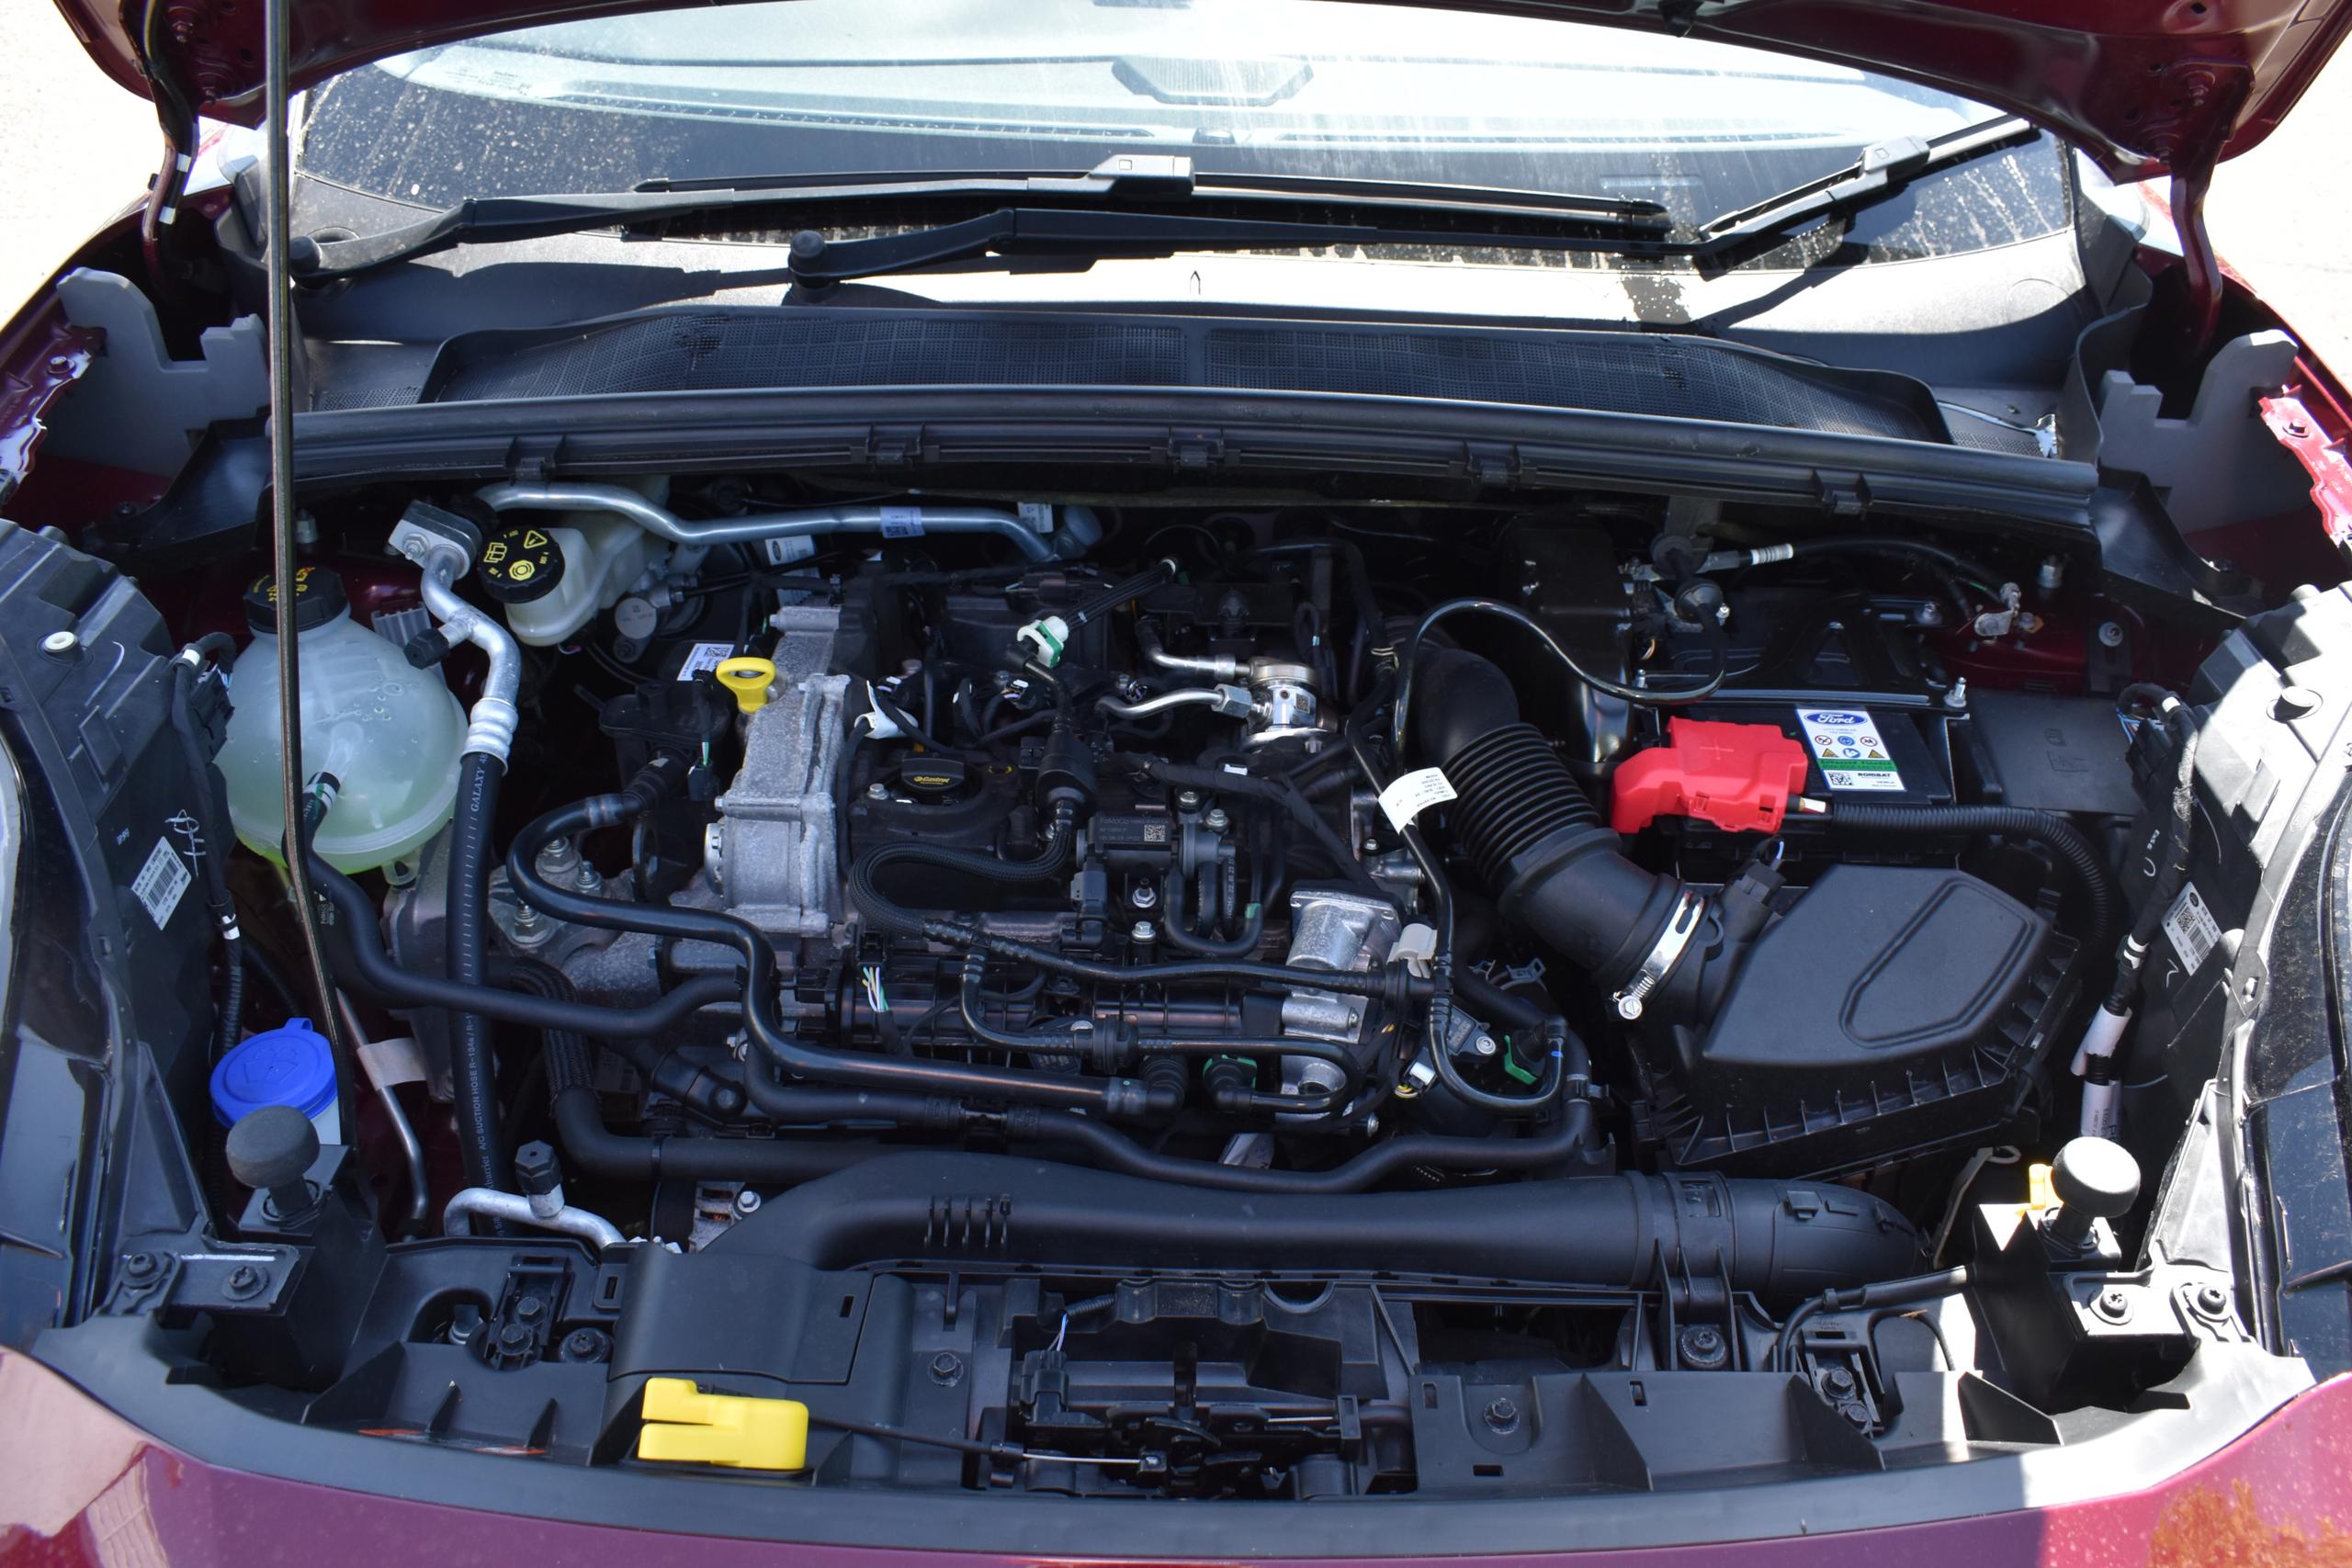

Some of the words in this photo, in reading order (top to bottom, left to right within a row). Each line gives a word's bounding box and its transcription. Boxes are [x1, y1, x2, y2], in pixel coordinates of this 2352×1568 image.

[471, 767, 485, 812] GALAXY
[468, 1038, 479, 1068] R-134a
[469, 1070, 479, 1095] HOSE
[472, 1096, 484, 1134] SUCTION
[478, 1135, 486, 1150] A/C
